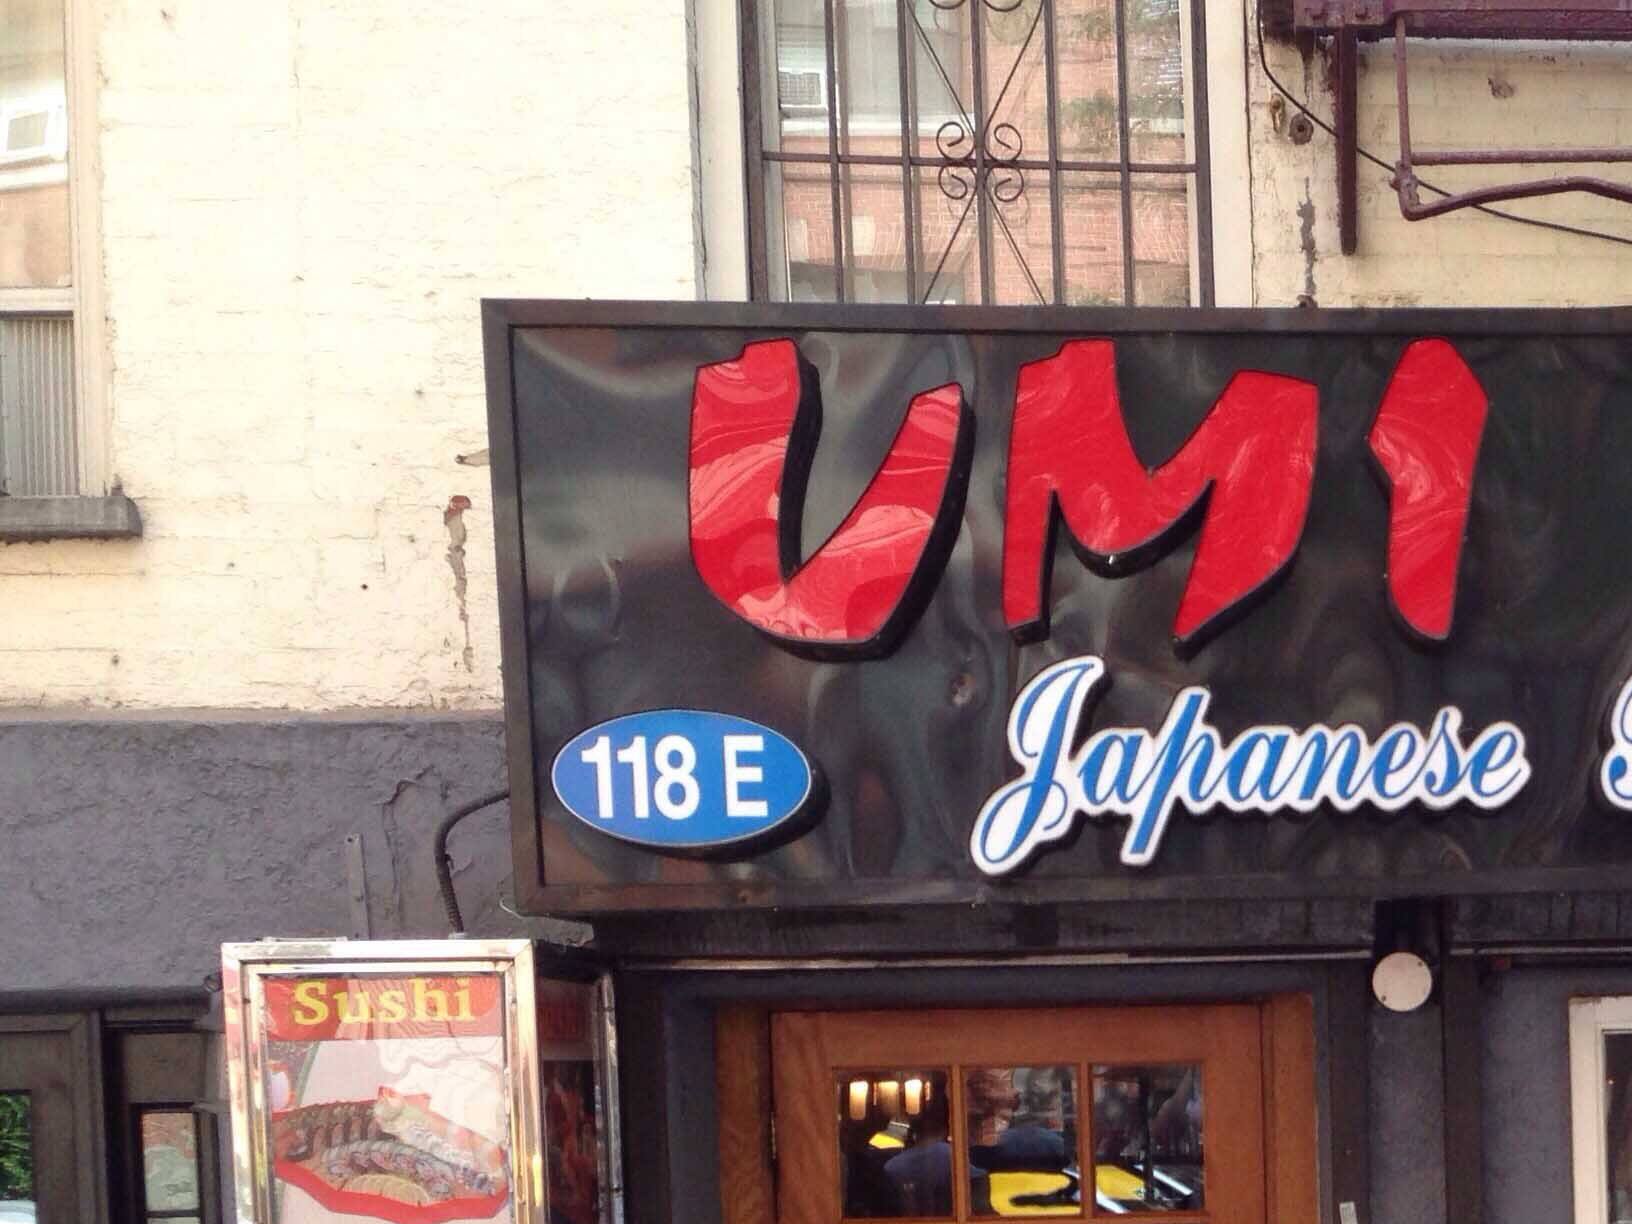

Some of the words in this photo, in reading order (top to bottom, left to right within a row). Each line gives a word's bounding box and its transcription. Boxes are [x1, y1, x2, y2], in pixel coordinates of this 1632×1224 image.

[687, 338, 1489, 644] UMI
[581, 735, 699, 820] 118
[723, 734, 767, 817] E
[974, 658, 1528, 871] Japanese
[291, 976, 475, 1025] Sushi
